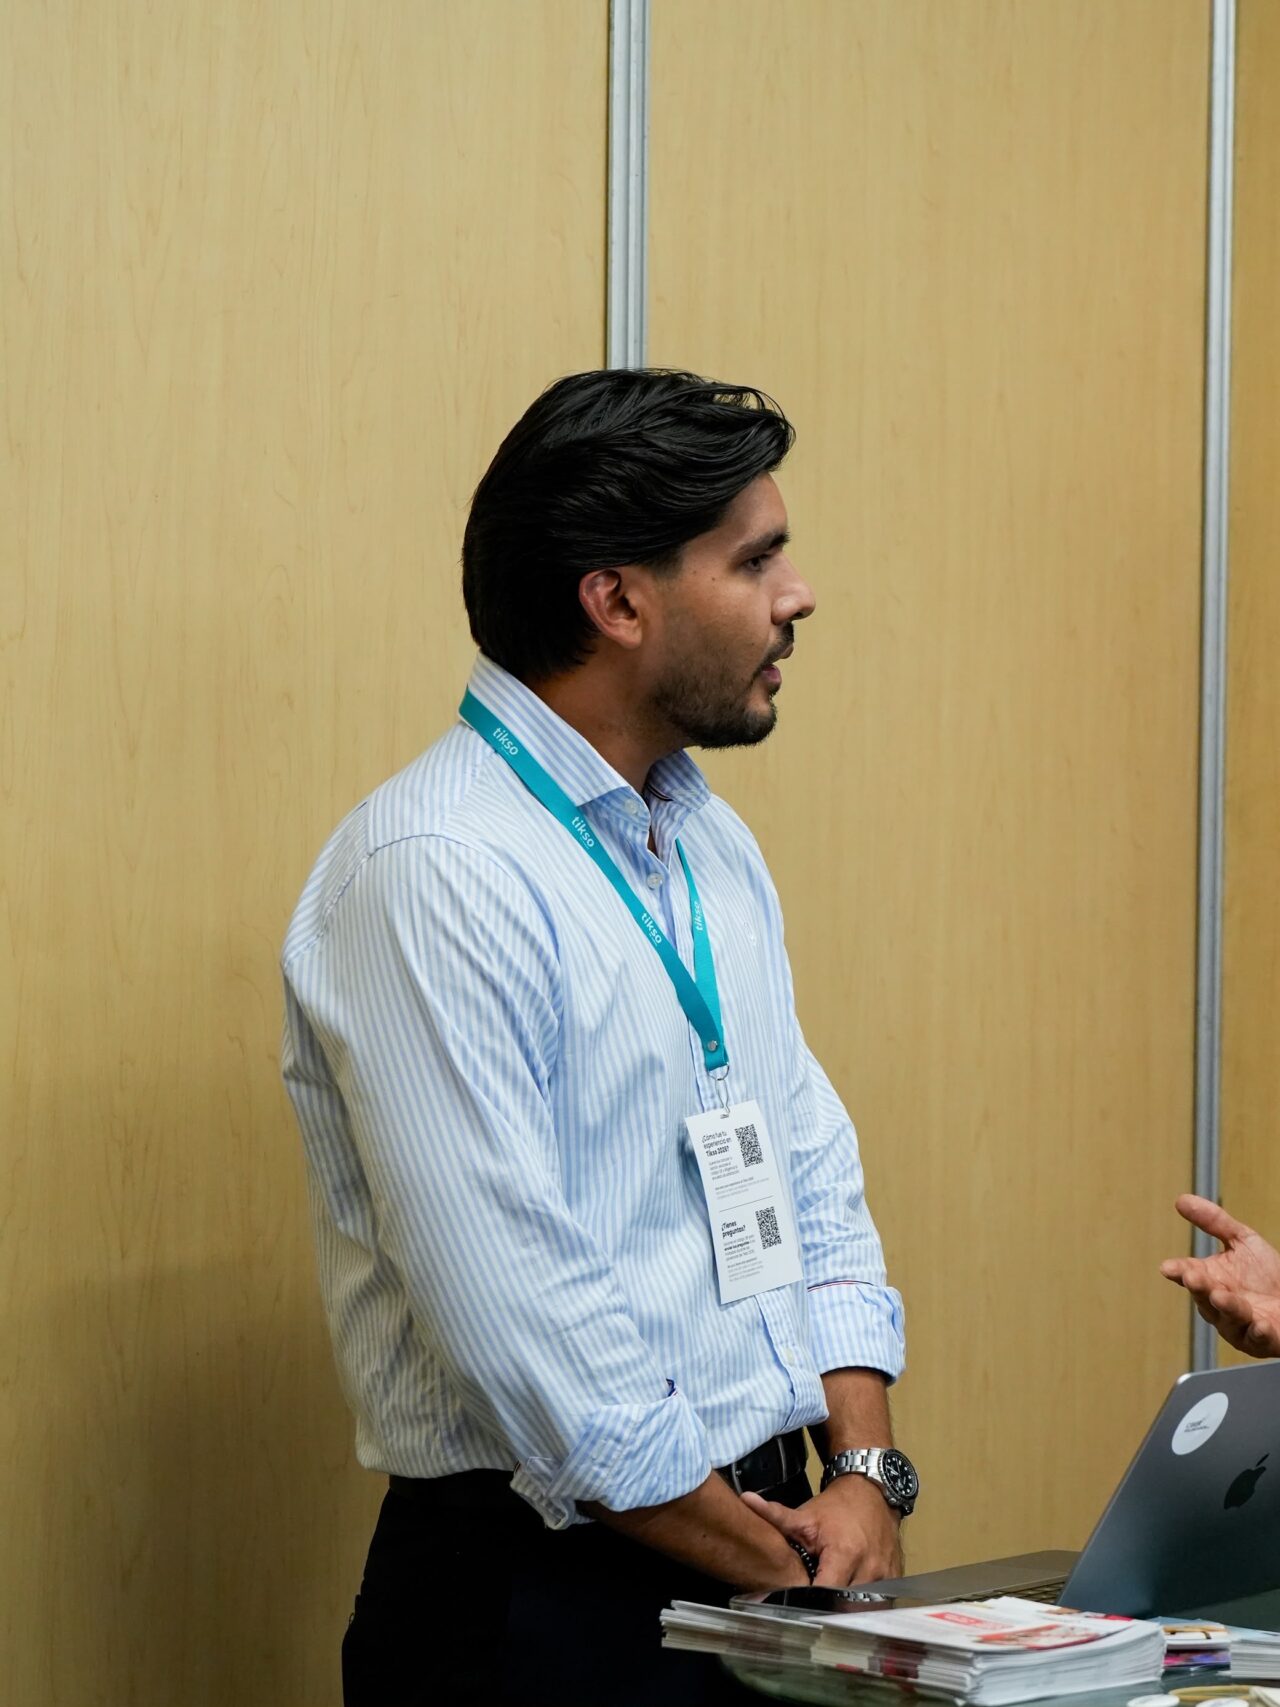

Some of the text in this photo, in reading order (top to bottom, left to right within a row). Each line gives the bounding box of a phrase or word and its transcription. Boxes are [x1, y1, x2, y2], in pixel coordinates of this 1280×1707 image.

[493, 727, 518, 756] tikso
[571, 816, 594, 848] tikso
[641, 912, 662, 944] tikso
